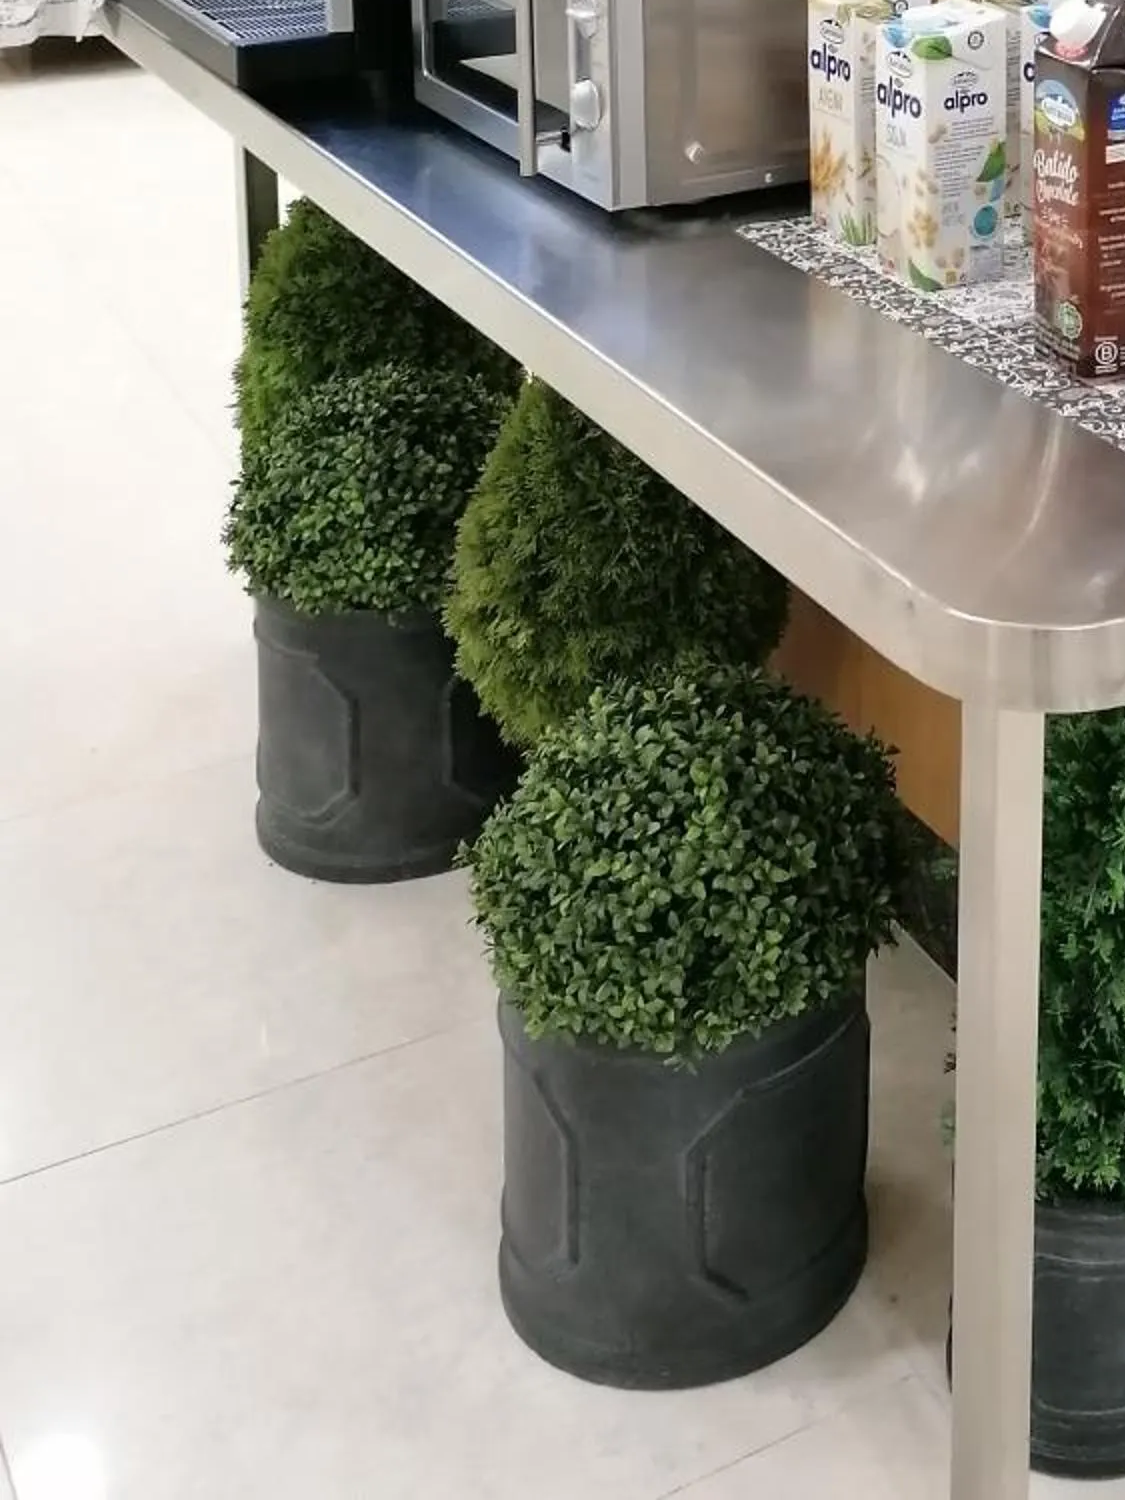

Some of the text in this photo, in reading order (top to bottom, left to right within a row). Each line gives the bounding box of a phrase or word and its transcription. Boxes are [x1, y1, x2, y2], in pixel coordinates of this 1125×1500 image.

[811, 43, 851, 82] alpro
[877, 75, 922, 119] alpro
[943, 89, 988, 114] alpro
[1033, 148, 1080, 184] Batido
